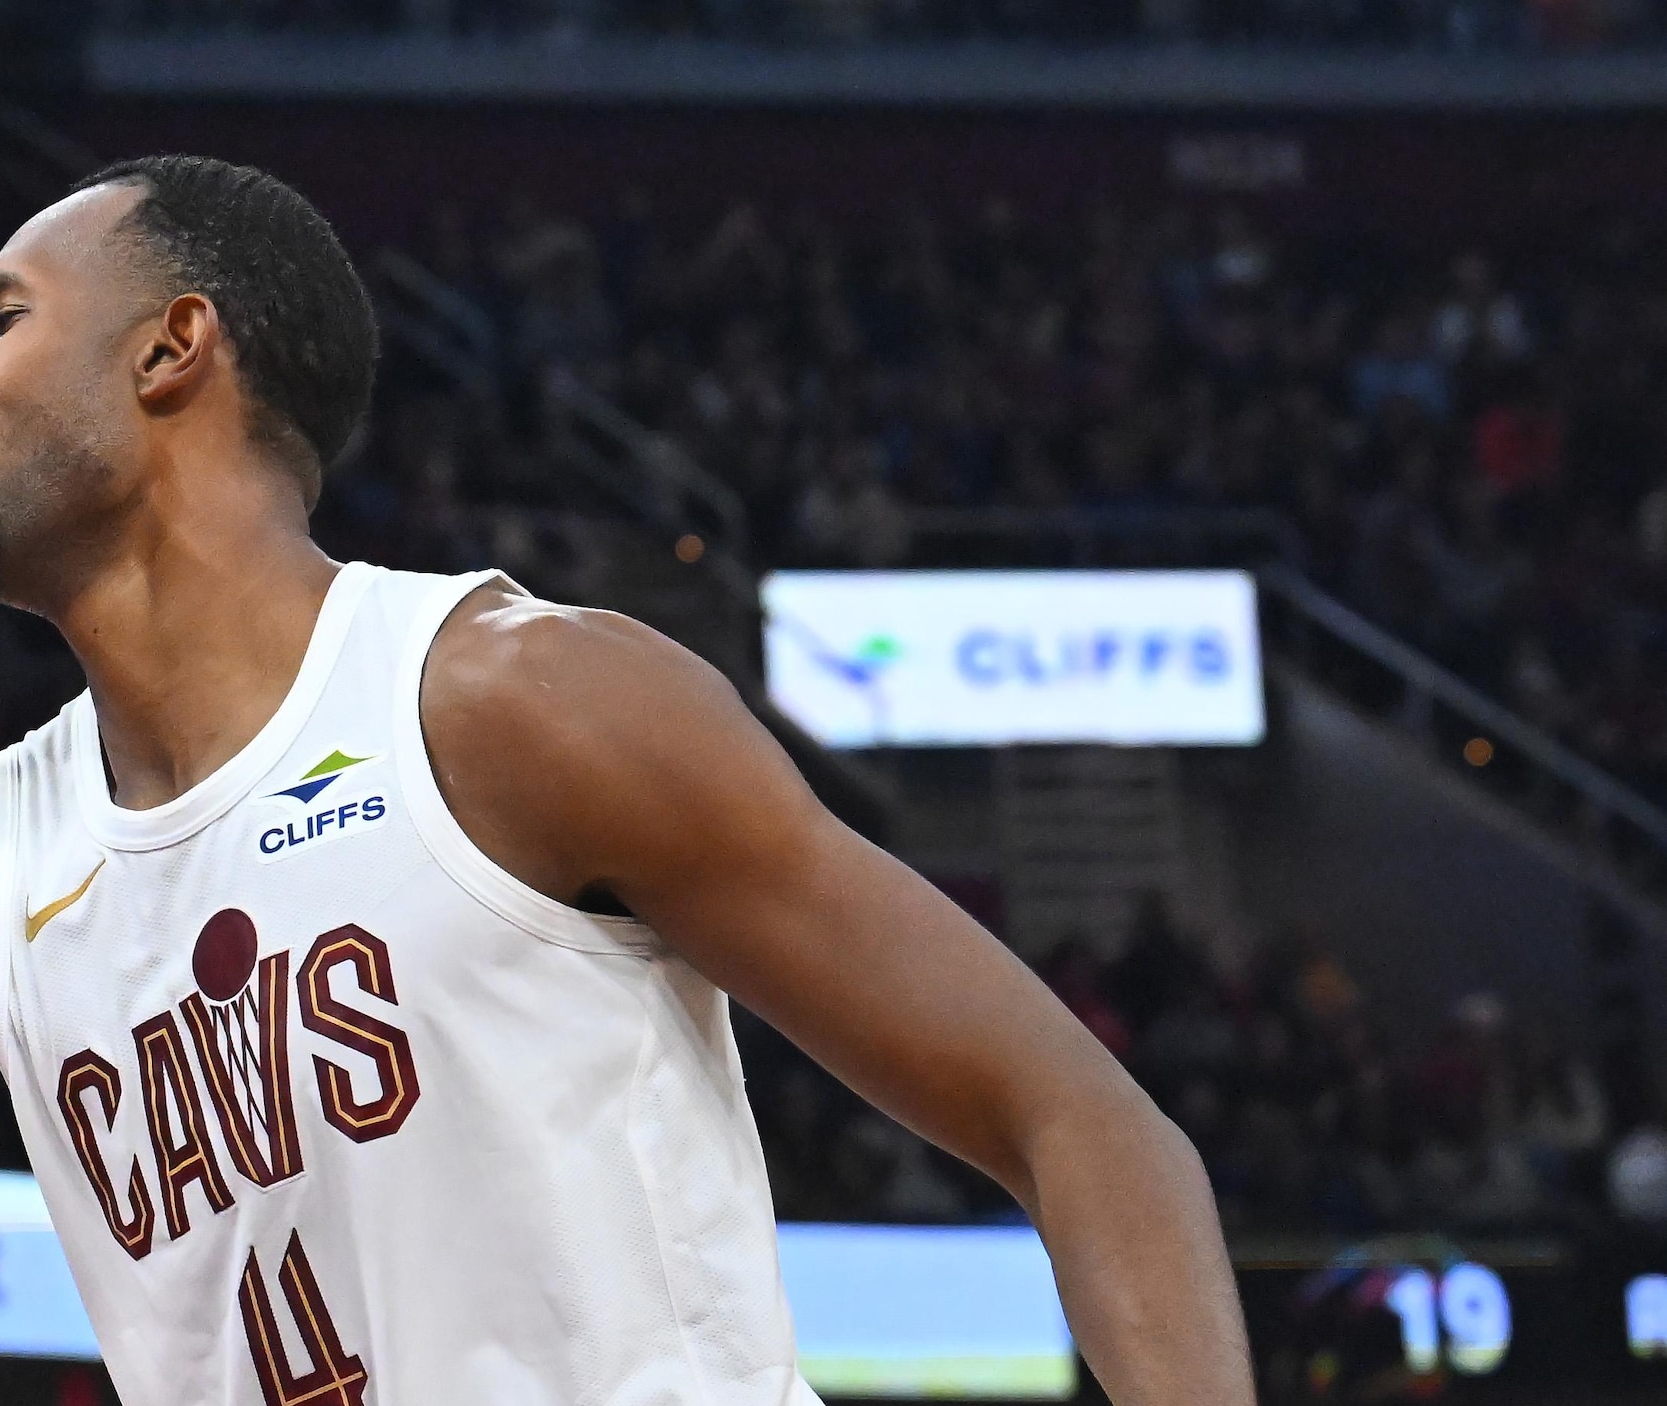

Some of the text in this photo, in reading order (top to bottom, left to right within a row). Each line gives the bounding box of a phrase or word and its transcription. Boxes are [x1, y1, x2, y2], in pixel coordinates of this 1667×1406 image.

[259, 796, 386, 854] CLIFFS
[56, 921, 421, 1262] CAVS
[1384, 1261, 1512, 1376] 19
